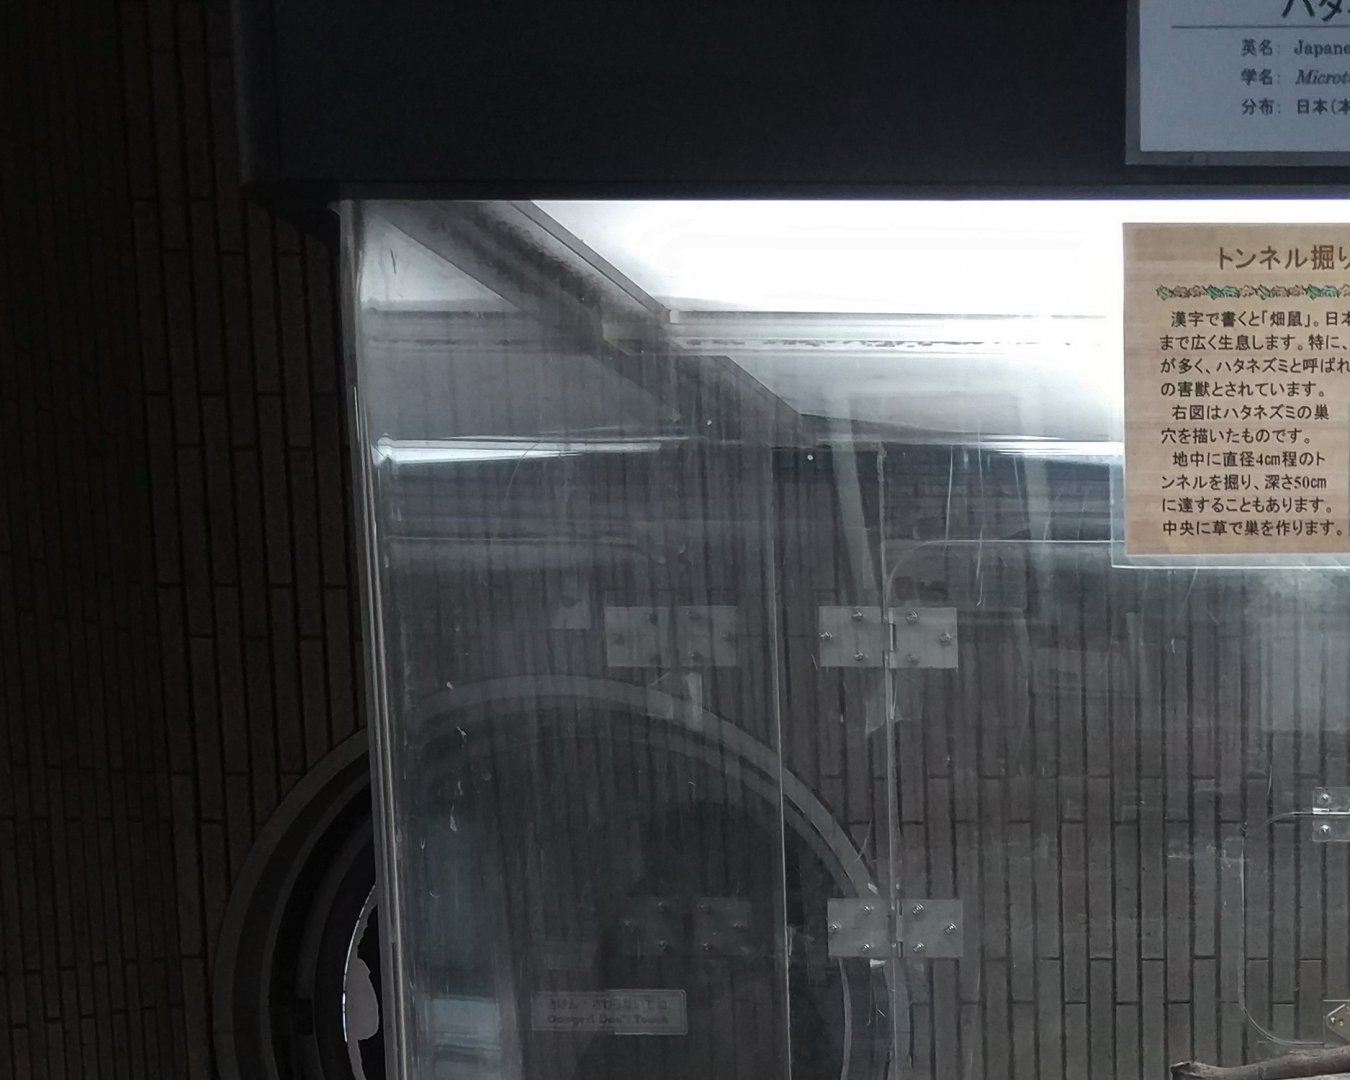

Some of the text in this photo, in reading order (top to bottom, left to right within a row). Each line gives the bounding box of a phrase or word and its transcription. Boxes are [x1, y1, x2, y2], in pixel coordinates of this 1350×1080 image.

[1161, 381, 1325, 398] の害獣とされています。
[1172, 404, 1329, 420] 右図はハタネズミの巣
[1161, 428, 1310, 444] 穴を描いたものです。
[1172, 451, 1325, 467] 地中に直径4cm程のト
[1161, 474, 1327, 490] ンネルを掘り、深さ50cm
[1162, 497, 1332, 513] に達することもあります。
[1163, 520, 1343, 536] 中央に草で巣を作ります。
